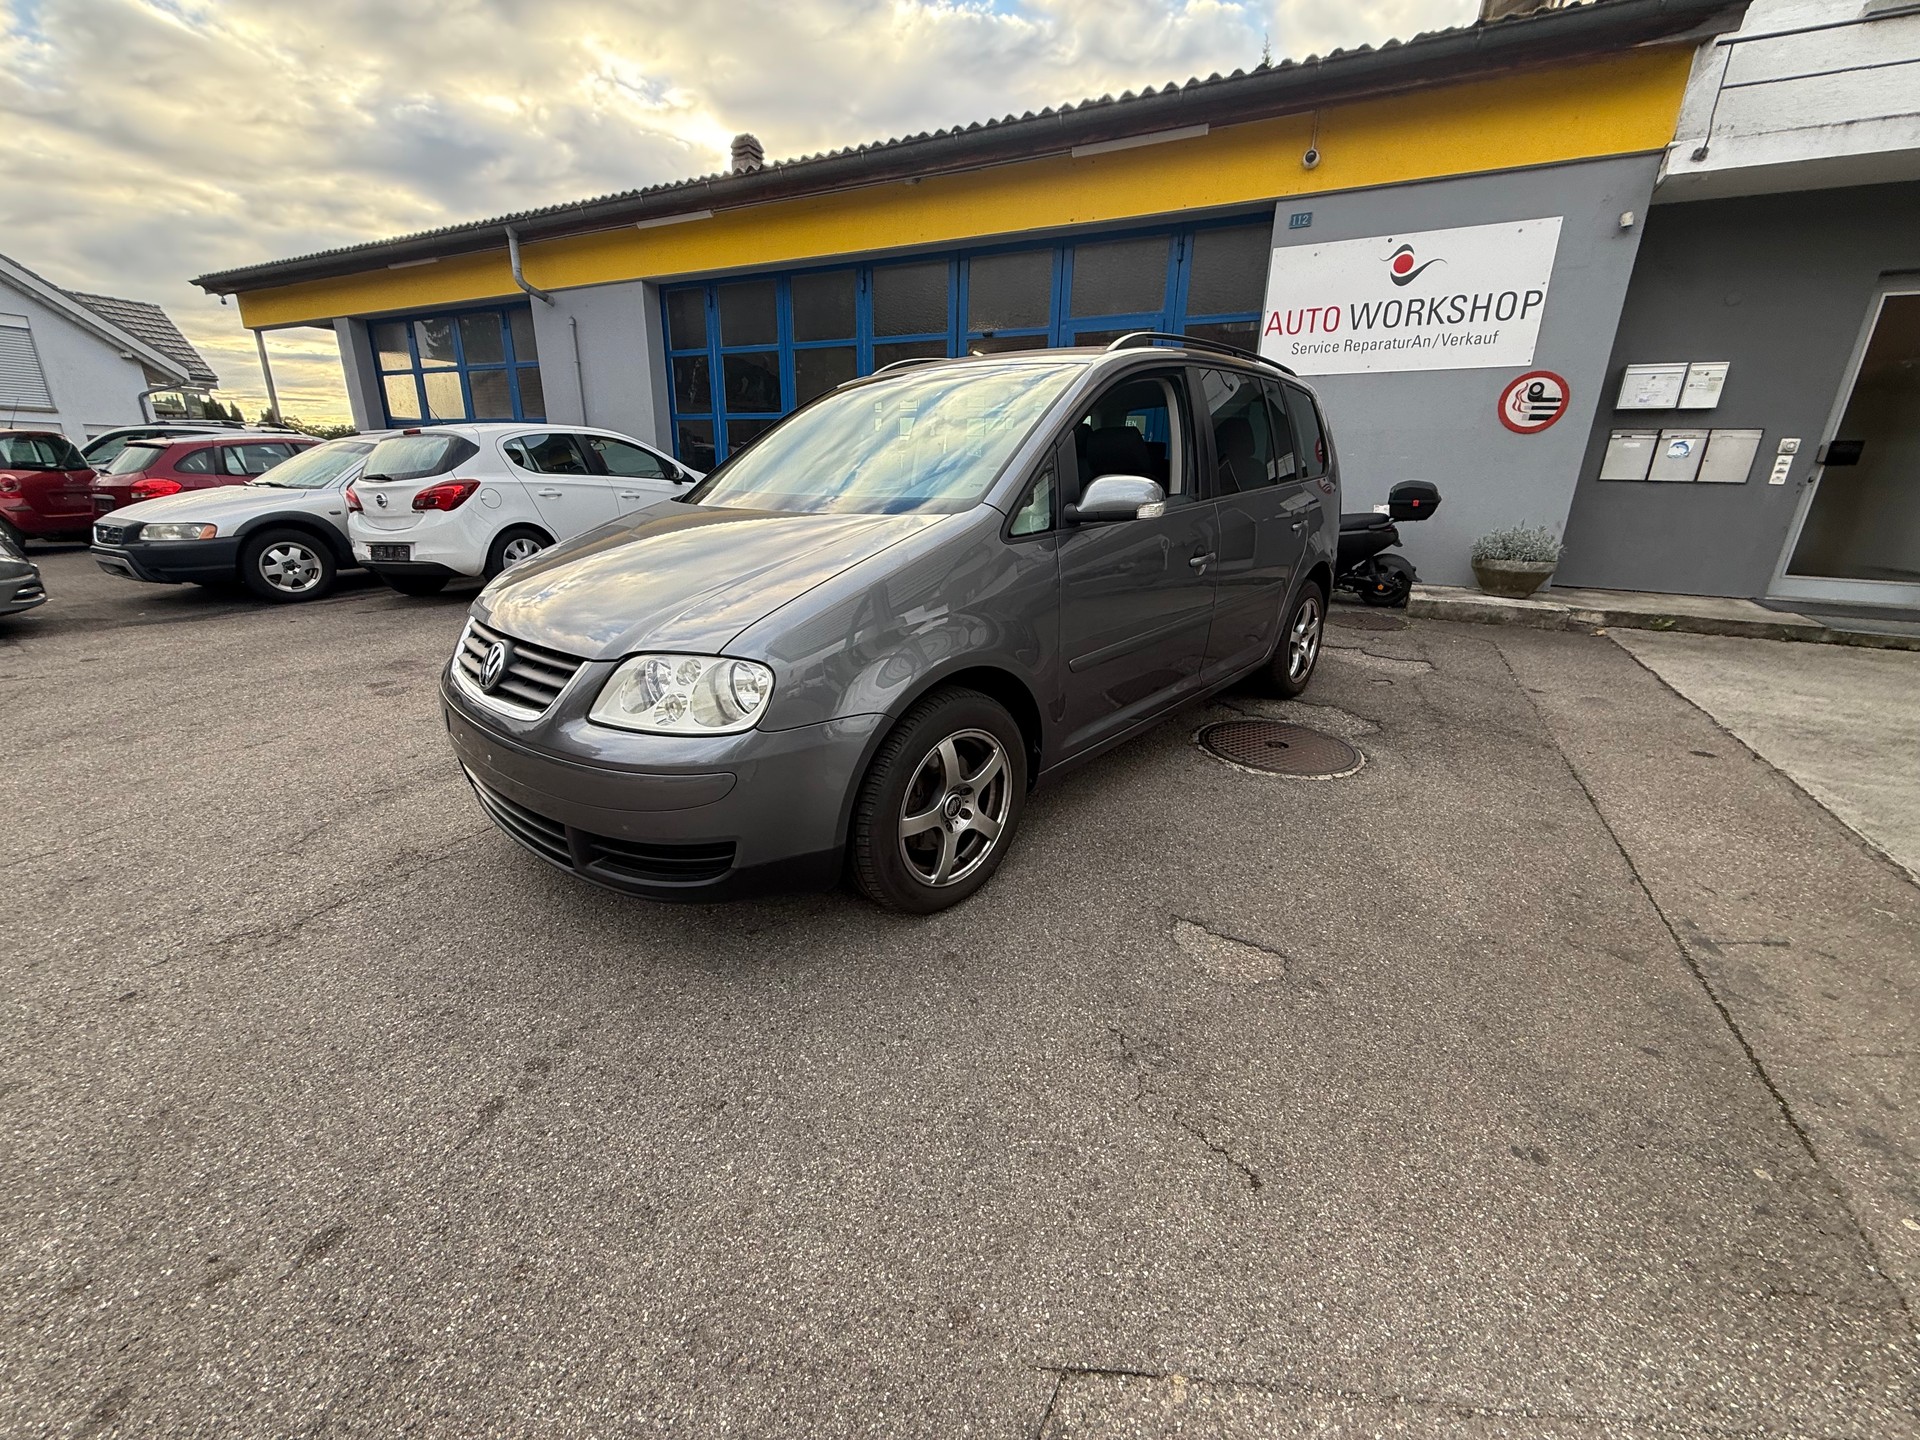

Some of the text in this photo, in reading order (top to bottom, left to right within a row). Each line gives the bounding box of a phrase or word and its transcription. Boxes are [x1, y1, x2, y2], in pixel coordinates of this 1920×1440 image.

[1292, 214, 1309, 226] 112
[1264, 289, 1544, 337] AUTO WORKSHOP
[1291, 340, 1340, 355] Service
